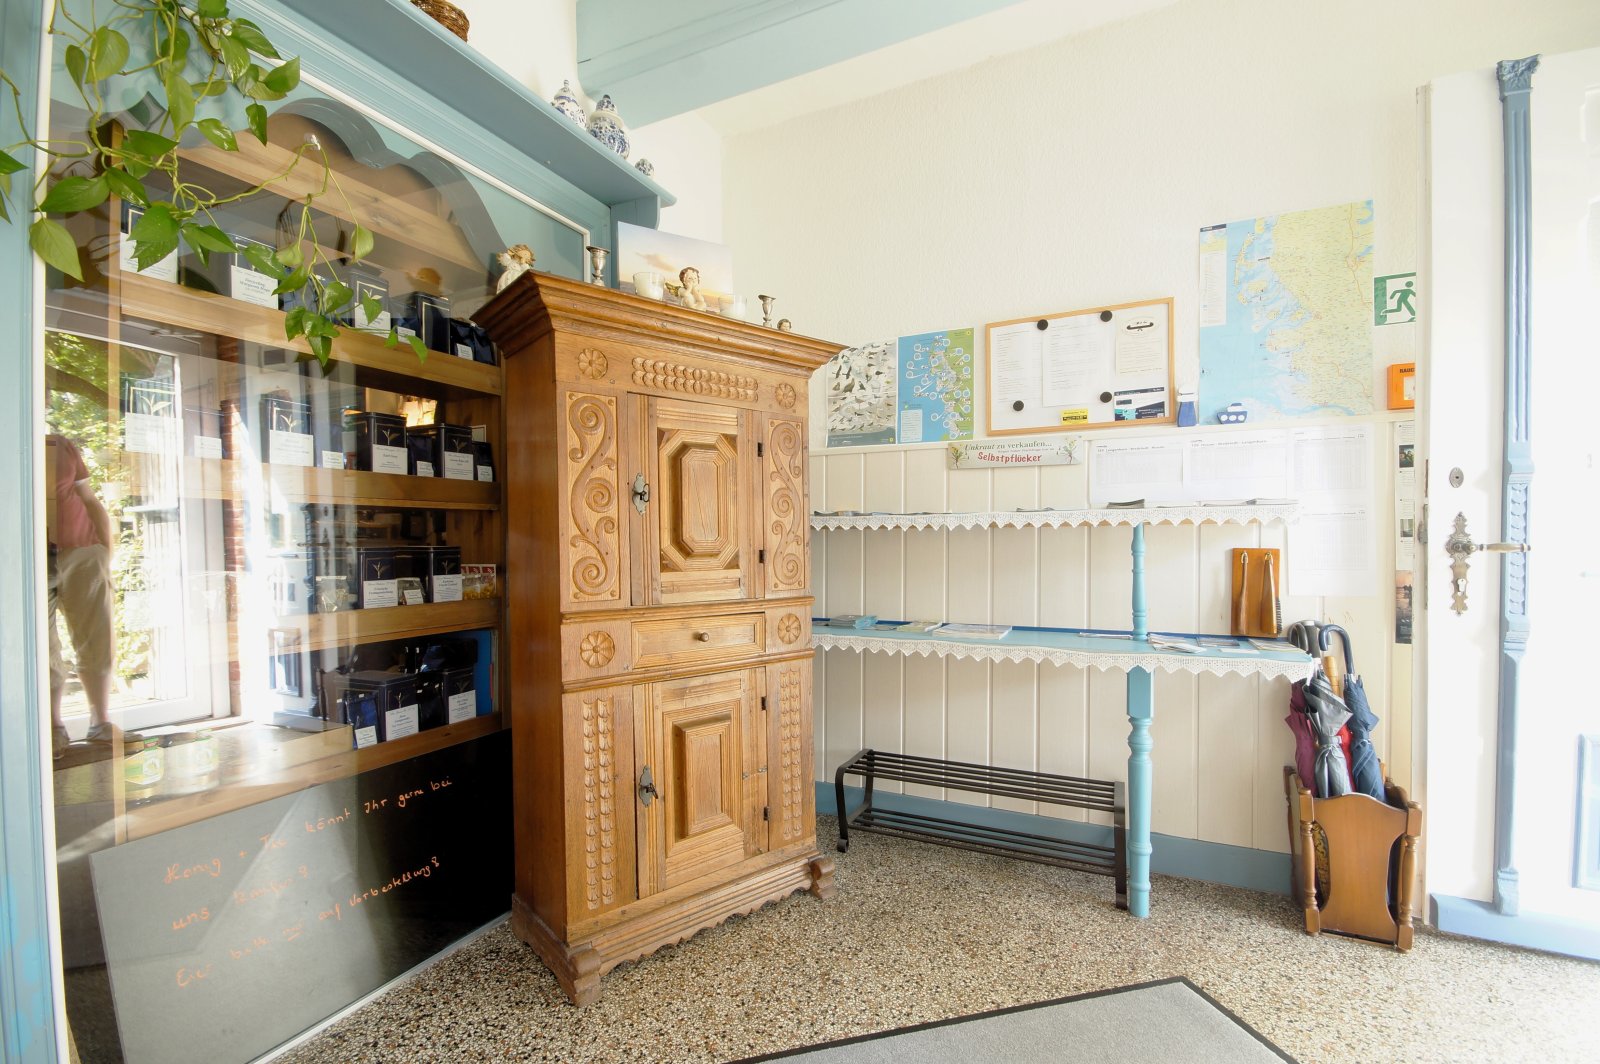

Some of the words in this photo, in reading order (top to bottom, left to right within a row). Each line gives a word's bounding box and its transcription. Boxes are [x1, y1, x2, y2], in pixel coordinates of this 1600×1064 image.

[964, 443, 995, 451] Unkraut
[1007, 440, 1052, 449] verkaufen...
[977, 451, 1042, 464] Selbstpflücker
[304, 808, 351, 833] könnt
[398, 790, 424, 808] gerne
[430, 776, 453, 791] bei
[172, 907, 210, 930] uns
